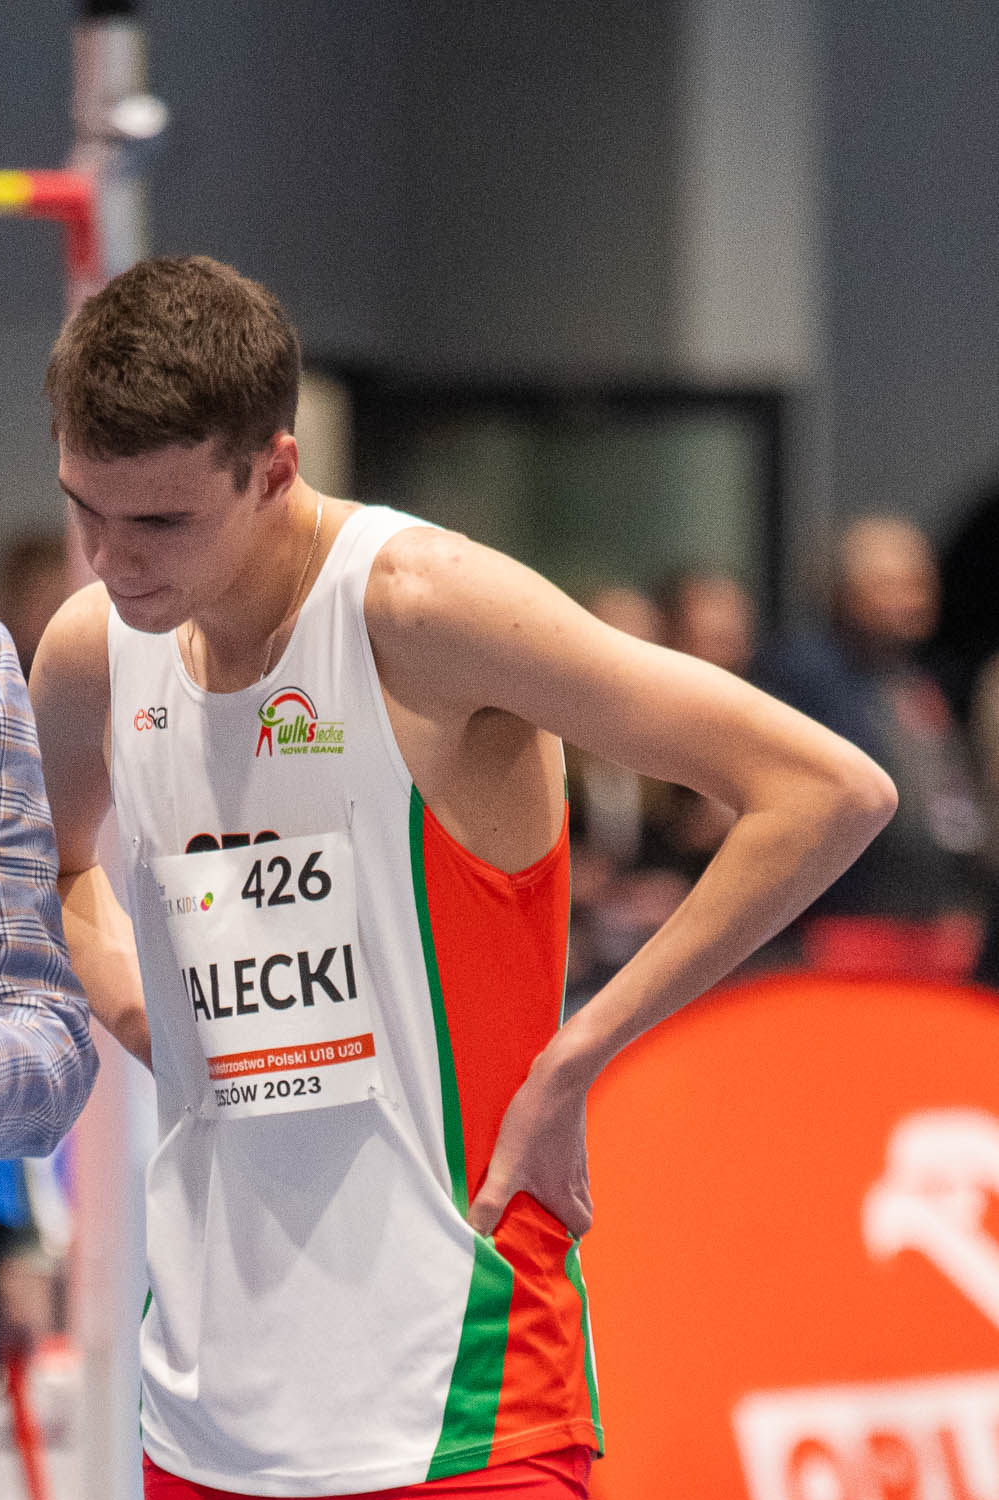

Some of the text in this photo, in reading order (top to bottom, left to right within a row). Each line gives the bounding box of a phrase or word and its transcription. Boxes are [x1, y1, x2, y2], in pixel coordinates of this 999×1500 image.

[280, 746, 309, 755] NOWE
[241, 851, 332, 908] 426
[182, 943, 358, 1022] ALECKI
[210, 1041, 363, 1076] istrzostwa Polski U18 U20
[264, 1076, 322, 1100] 2023
